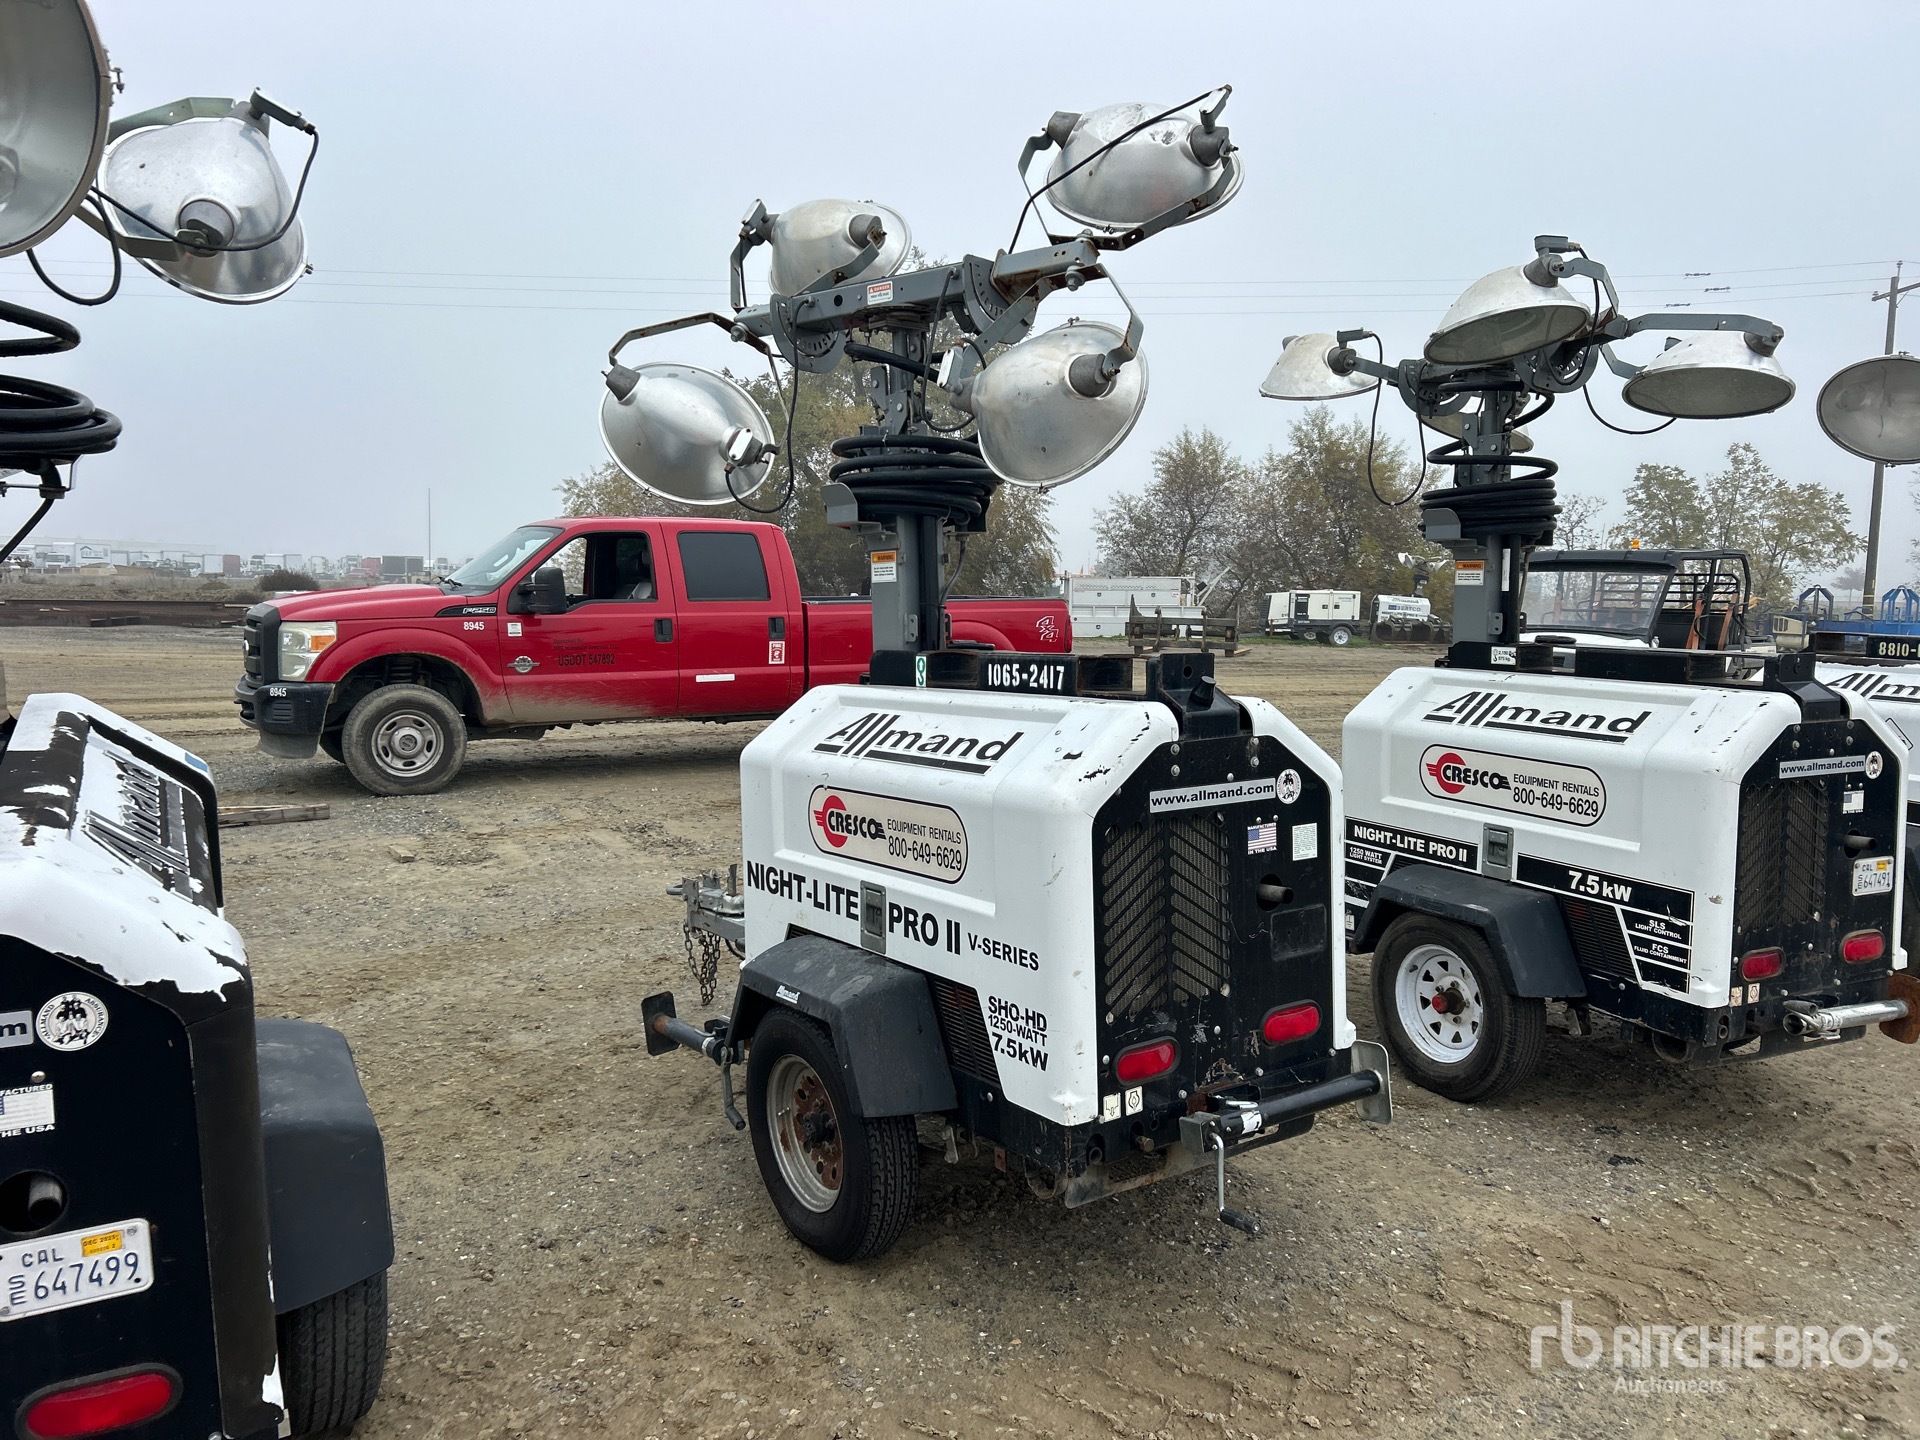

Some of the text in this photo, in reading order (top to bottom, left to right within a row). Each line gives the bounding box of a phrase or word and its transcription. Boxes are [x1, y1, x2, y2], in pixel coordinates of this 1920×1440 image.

[463, 621, 485, 631] 8945
[558, 653, 587, 667] USDOT
[988, 663, 1065, 690] 1065-2417
[269, 687, 287, 698] 8945
[1432, 691, 1652, 736] Allmand
[825, 712, 1025, 762] Allmand
[1442, 764, 1511, 790] CRESCO
[1780, 758, 1864, 774] www.allmand.com
[1151, 782, 1275, 807] www.allmand.com
[1513, 774, 1600, 797] EQUIPMENT RENTALS
[1513, 787, 1599, 818] 800-649-6629
[827, 809, 886, 840] CRESCO
[887, 818, 962, 845] EQUIPMENT RENTALS
[888, 837, 962, 871] 800-649-6629
[1354, 824, 1425, 852] NIGHT-LITE
[1428, 841, 1458, 860] PRO
[1364, 849, 1382, 859] WATT
[1363, 855, 1382, 864] SYSTEM
[1568, 870, 1632, 902] 7.5 kW
[746, 860, 859, 921] NIGHT-LITE
[888, 902, 939, 946] PRO
[1635, 923, 1682, 940] LIGHT CONTROL
[1649, 919, 1666, 930] SLS
[967, 932, 1040, 971] V-SERIES
[1634, 945, 1687, 964] FLUID CONTAINMENT
[1652, 943, 1669, 954] FCS
[988, 995, 1048, 1032] SHO-HD
[988, 1014, 1048, 1047] 1250-WATT
[991, 1032, 1049, 1071] 7.5kW
[0, 1124, 55, 1138] HE USA
[21, 1248, 65, 1268] CAL
[34, 1252, 139, 1300] 647499
